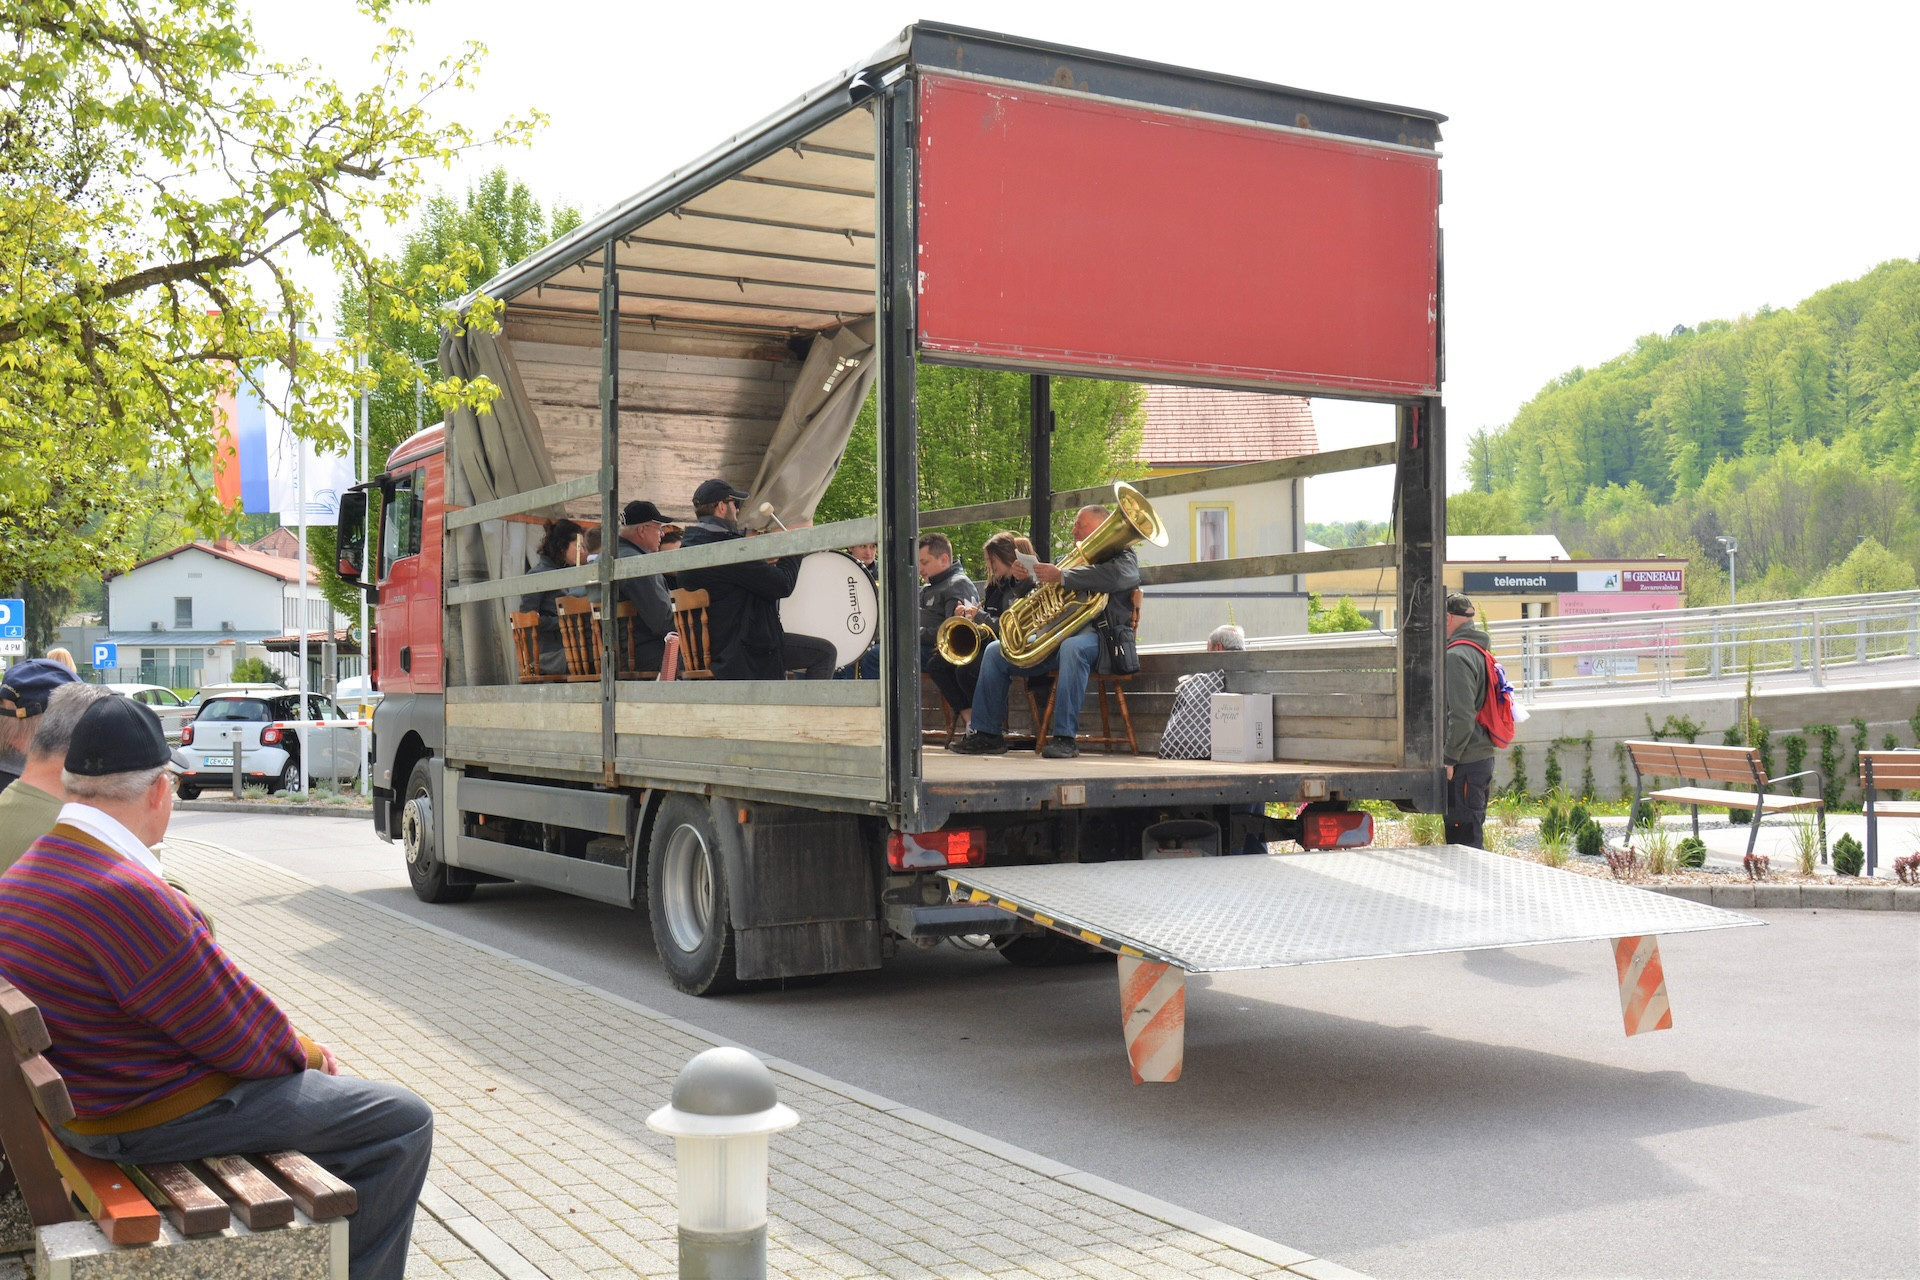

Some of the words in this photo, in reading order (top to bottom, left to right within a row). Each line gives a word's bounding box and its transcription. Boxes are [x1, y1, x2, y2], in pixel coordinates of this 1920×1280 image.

[1494, 575, 1547, 588] telemach
[1632, 571, 1681, 582] GENERALI
[95, 646, 109, 665] P
